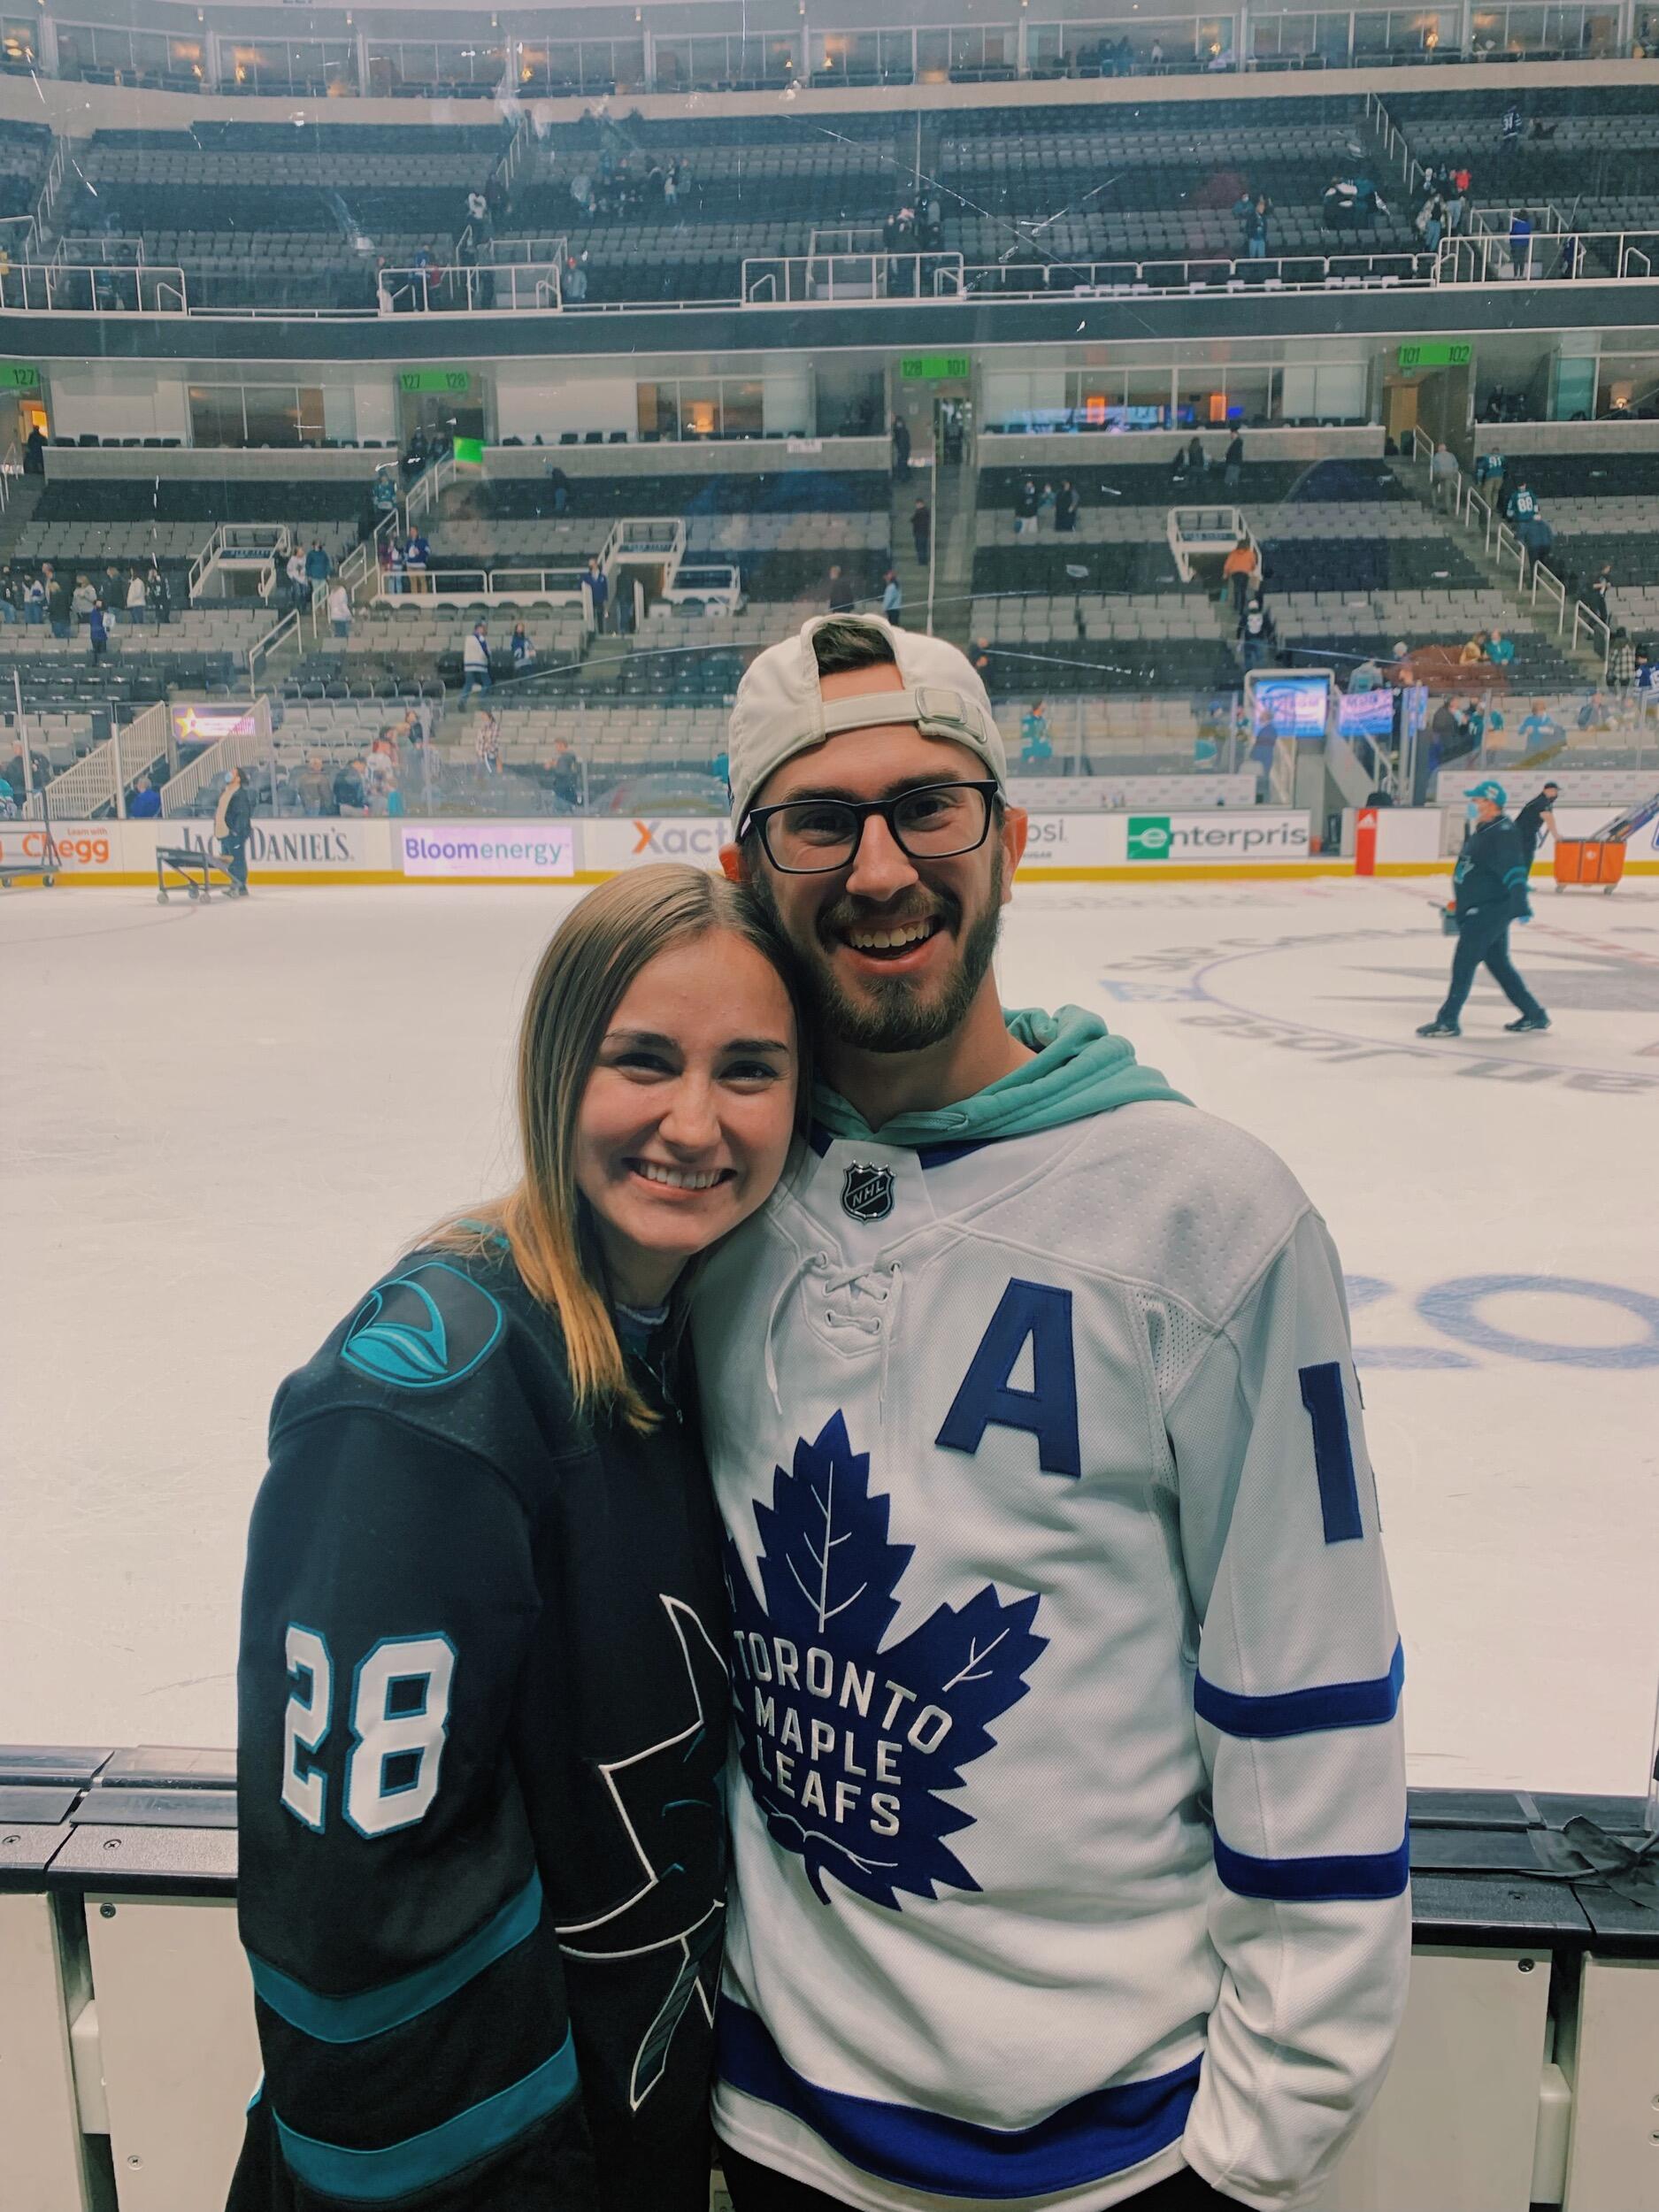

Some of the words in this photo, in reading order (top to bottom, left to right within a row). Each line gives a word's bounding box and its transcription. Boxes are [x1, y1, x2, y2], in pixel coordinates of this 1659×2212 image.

[948, 359, 966, 376] 101
[1402, 347, 1421, 364] 101
[1449, 345, 1470, 362] 102
[13, 368, 35, 385] 127
[402, 373, 420, 389] 127
[446, 373, 466, 388] 128
[67, 827, 89, 836] Learn
[91, 827, 108, 836] with
[249, 826, 350, 862] DANIEL'S
[852, 1180, 885, 1207] NHL
[934, 1277, 1081, 1479] A
[1298, 1361, 1382, 1544] 1
[733, 1630, 953, 1755] TORONTO
[280, 1622, 458, 1839] 28
[754, 1686, 902, 1786] MAPLE
[757, 1735, 901, 1837] LEAFS
